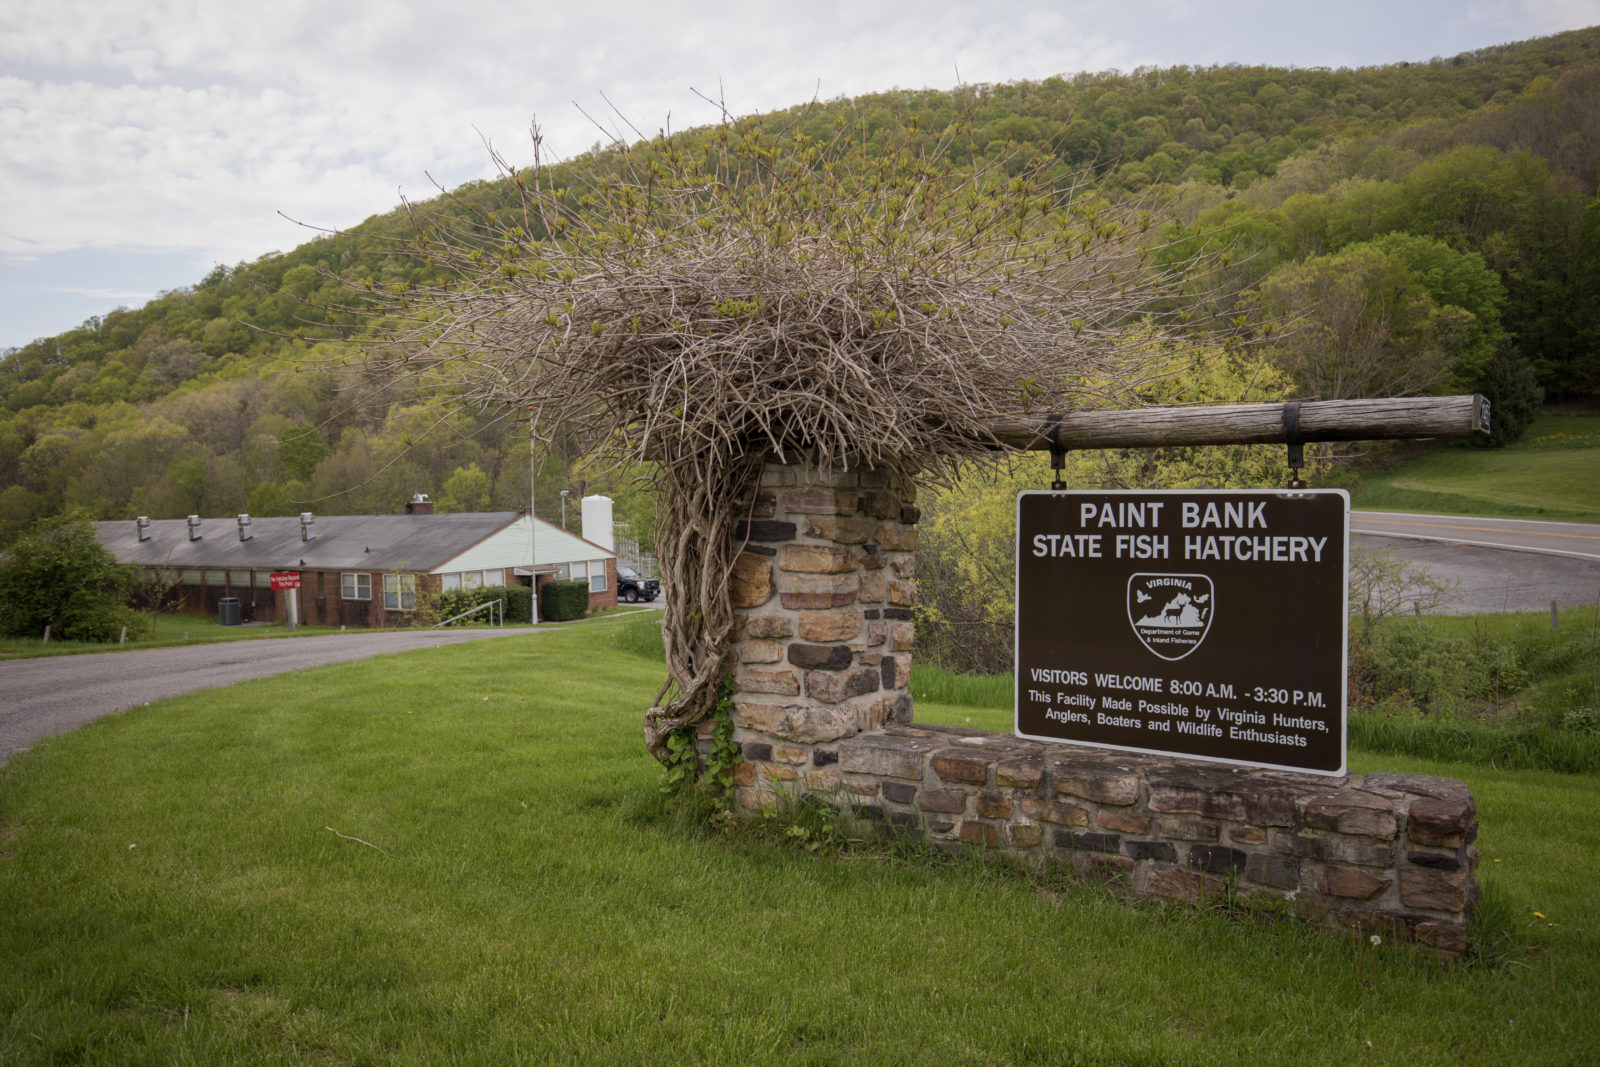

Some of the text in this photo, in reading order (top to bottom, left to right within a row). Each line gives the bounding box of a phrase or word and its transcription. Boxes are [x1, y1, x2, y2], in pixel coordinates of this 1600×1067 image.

[1081, 502, 1268, 528] PAINT BANK
[1032, 534, 1327, 562] STATE FISH HATCHERY
[1146, 578, 1192, 590] VIRGINIA
[1031, 668, 1088, 685] VISITORS
[1095, 673, 1163, 692] WELCOME
[1170, 680, 1202, 696] 8:00
[1206, 683, 1237, 699] A.M.
[1293, 690, 1327, 708] P.M.
[1028, 690, 1330, 733] This Facility Made Possible by Virginia Hunters,
[1045, 707, 1307, 747] Anglers, Boaters and Wildlife Enthusiasts
